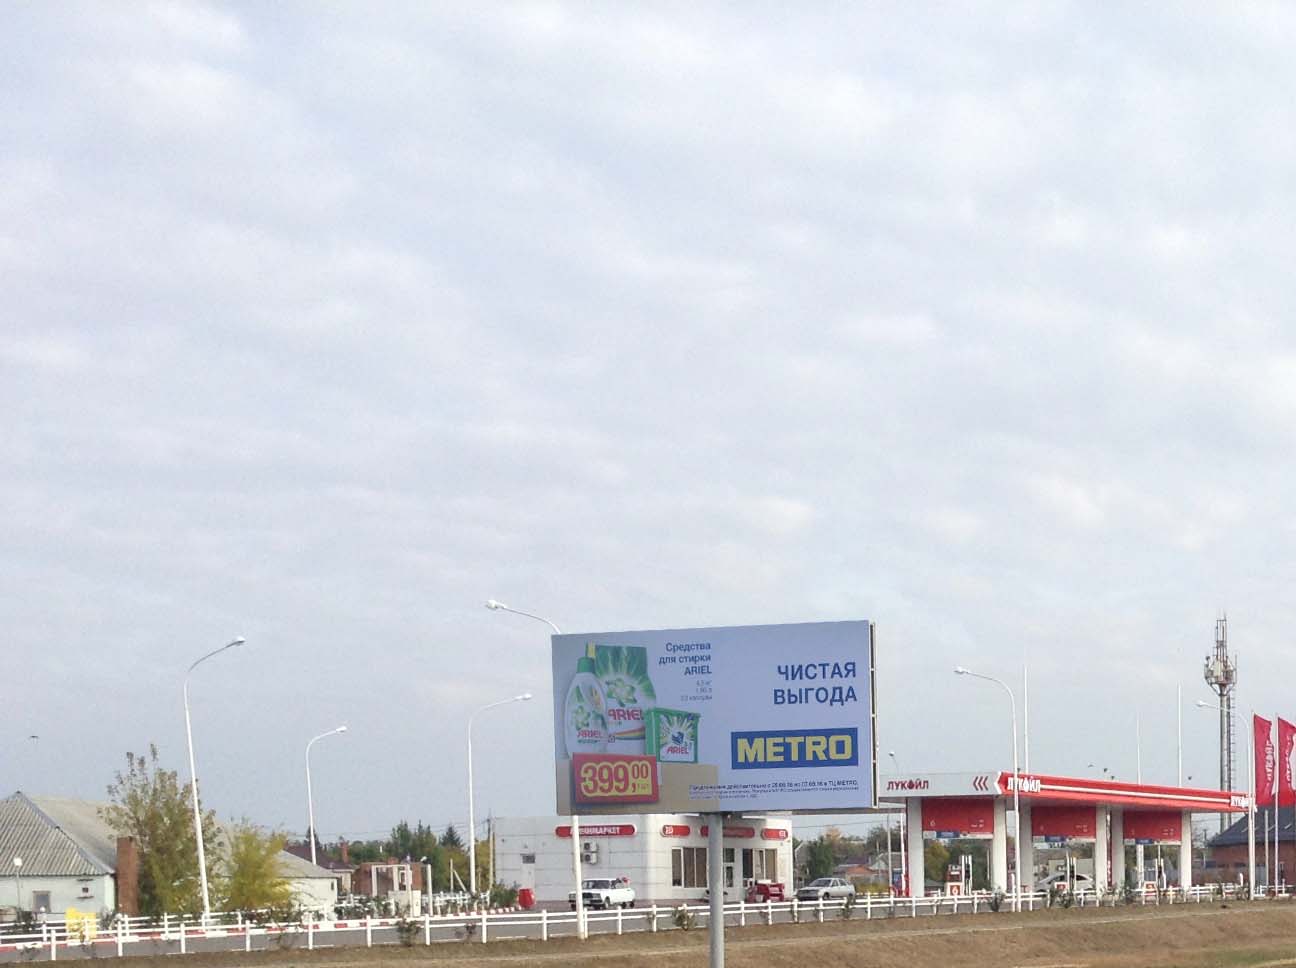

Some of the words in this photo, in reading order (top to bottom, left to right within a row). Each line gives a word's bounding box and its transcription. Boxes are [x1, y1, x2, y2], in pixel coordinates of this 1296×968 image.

[665, 642, 711, 653] Средства
[659, 656, 676, 665] для
[679, 654, 711, 664] стирки
[684, 665, 713, 676] ARIEL
[777, 662, 857, 681] ЧИСТАЯ
[773, 686, 857, 706] ВЫГОДА
[737, 734, 852, 763] METRO
[886, 778, 930, 791] ЛУКОЙЛ
